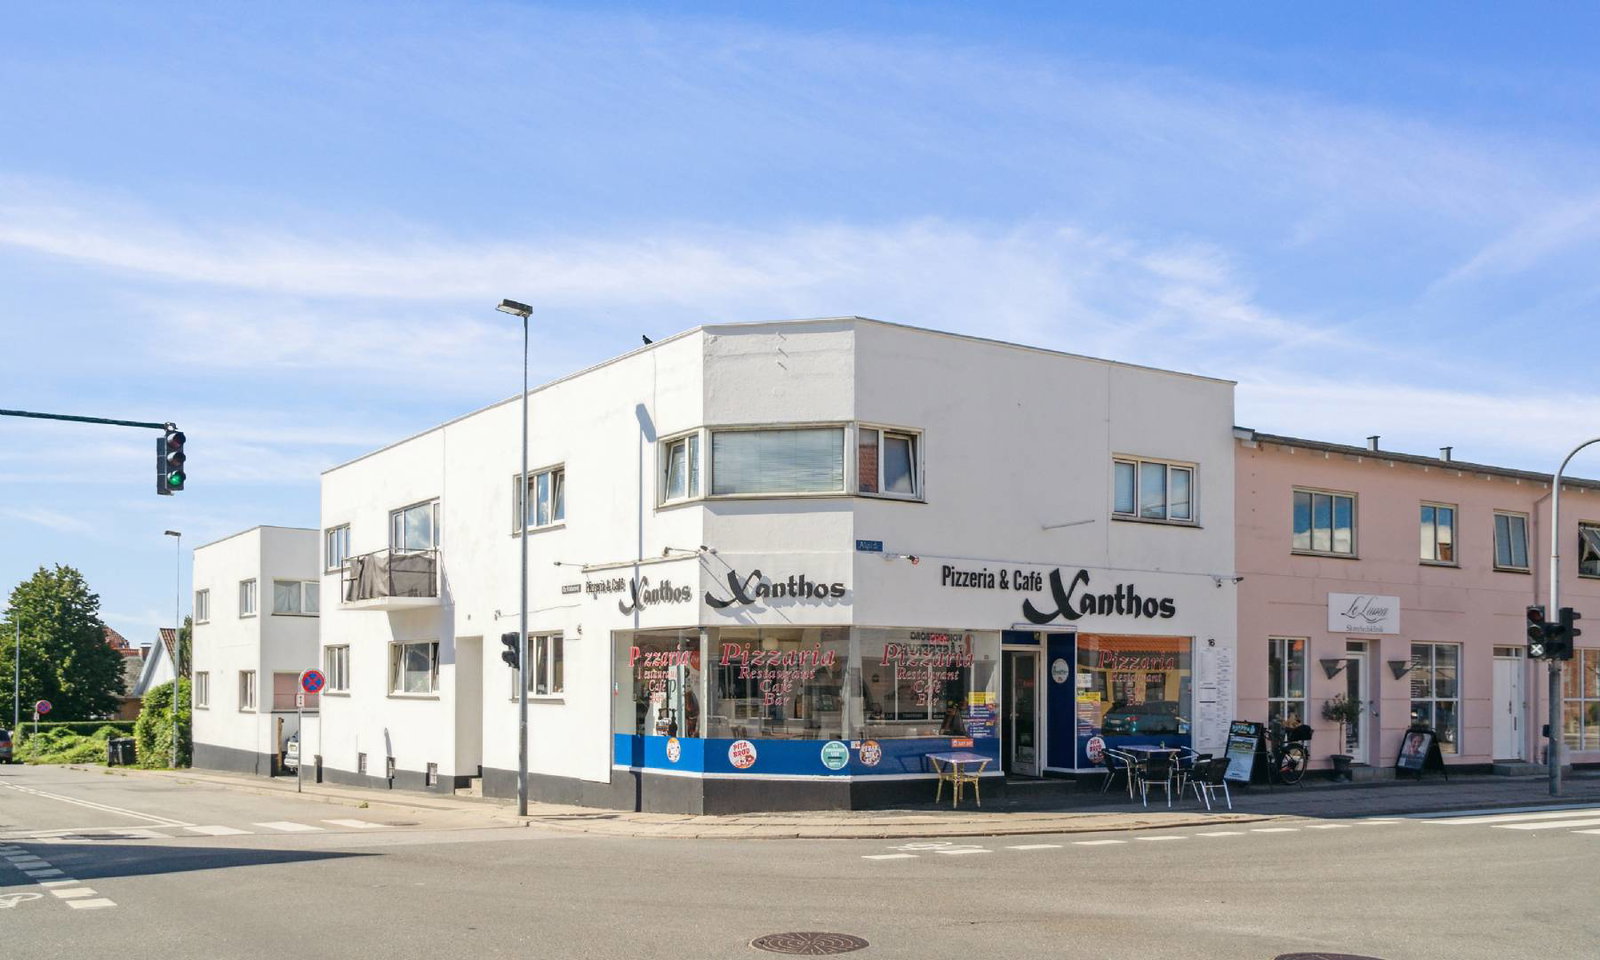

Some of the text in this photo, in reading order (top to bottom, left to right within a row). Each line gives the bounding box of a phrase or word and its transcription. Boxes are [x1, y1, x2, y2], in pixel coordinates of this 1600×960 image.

[705, 569, 846, 608] Xanthos
[942, 565, 1042, 592] Pizzeria & Café
[619, 576, 691, 616] Xanthos
[1023, 568, 1175, 624] Xanthos
[628, 643, 689, 667] Pzzaria
[719, 643, 836, 666] Pizzaria
[880, 643, 975, 667] Pizzaria
[1097, 649, 1175, 670] Pizzaria
[738, 666, 816, 680] Restaurant
[897, 667, 959, 680] Restaurant
[760, 680, 793, 695] Café
[763, 692, 789, 706] Bar
